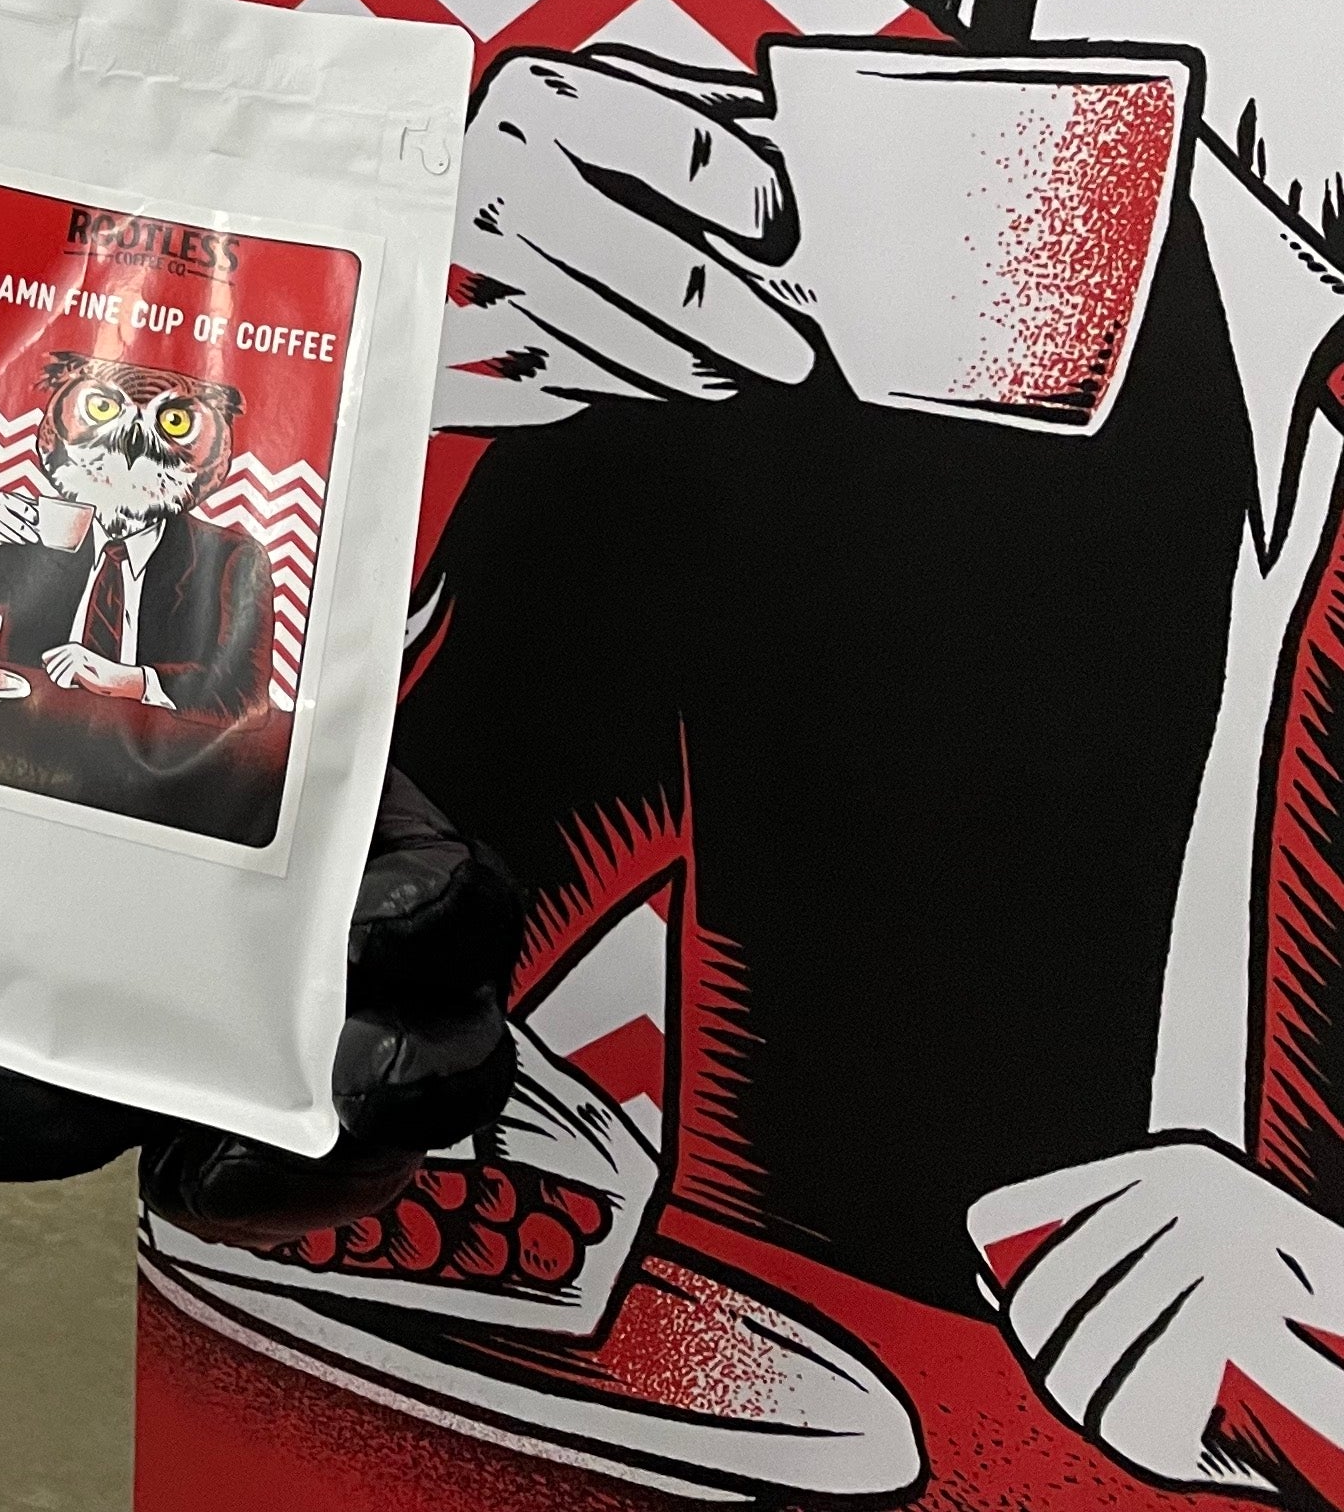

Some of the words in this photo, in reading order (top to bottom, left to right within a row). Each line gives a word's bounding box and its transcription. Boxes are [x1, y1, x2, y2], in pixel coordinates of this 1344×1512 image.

[66, 207, 240, 273] ROOTLESS
[63, 288, 123, 325] FINE
[130, 299, 184, 336] CUP
[193, 313, 228, 347] OF
[235, 321, 337, 363] COFFEE
